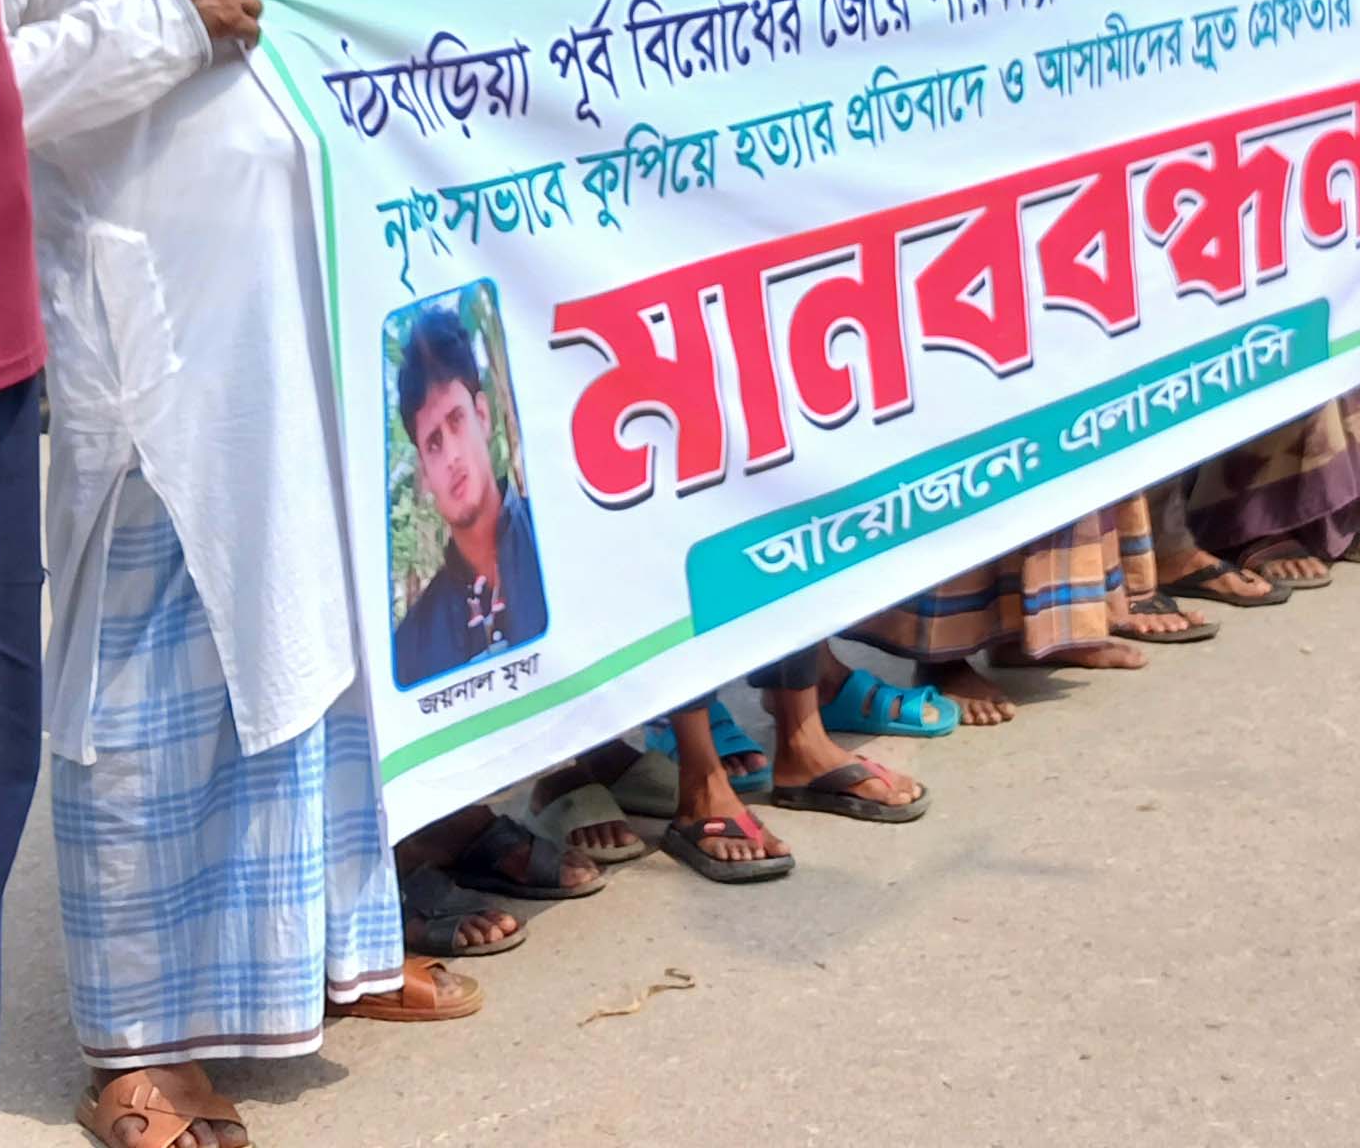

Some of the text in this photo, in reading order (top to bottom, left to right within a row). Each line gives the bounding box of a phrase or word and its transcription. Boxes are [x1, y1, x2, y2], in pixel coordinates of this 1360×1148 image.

[575, 122, 720, 232] কুপিয়ে
[726, 100, 838, 180] হত্যার
[846, 64, 990, 148] প্রতিবাদে
[998, 58, 1027, 105] ও
[1033, 11, 1185, 98] আসামীদের
[1058, 324, 1296, 453] এলাকাবাসি
[417, 652, 541, 715] জয়নাল মৃধা
